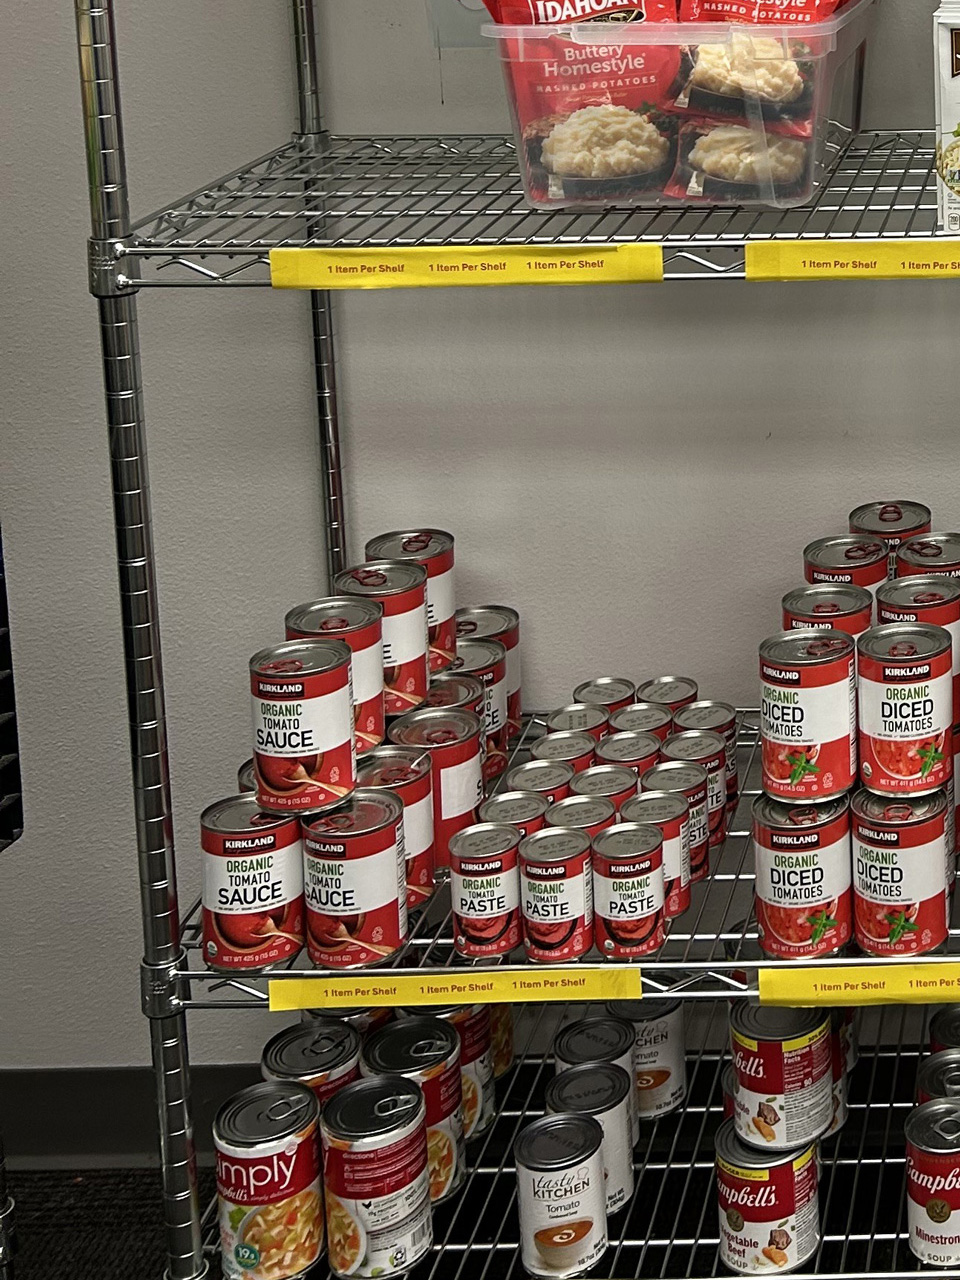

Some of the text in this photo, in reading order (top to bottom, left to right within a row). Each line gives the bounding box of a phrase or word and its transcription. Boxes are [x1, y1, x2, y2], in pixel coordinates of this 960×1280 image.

[564, 45, 624, 62] Buttery
[544, 55, 645, 77] Homestyle
[592, 75, 656, 88] POTATOES
[885, 666, 930, 675] KIRKLAND
[259, 683, 302, 692] KIRKLAND
[886, 685, 930, 700] ORGANIC
[261, 703, 302, 717] ORGANIC
[881, 698, 934, 719] DICED
[263, 717, 300, 730] TOMATO
[882, 718, 933, 732] TOMATOES
[256, 730, 313, 748] SAUCE
[461, 862, 501, 870] KIRKLAND
[462, 877, 500, 889] ORGANIC
[468, 890, 494, 898] TOMATO
[460, 896, 506, 912] PASTE
[821, 983, 841, 991] Item
[844, 982, 859, 990] Per
[861, 981, 886, 990] Shelf
[217, 1151, 296, 1195] imply
[533, 1178, 590, 1198] KITCHEN
[536, 1174, 575, 1189] tasty
[545, 1200, 580, 1213] Tomato
[727, 1242, 746, 1258] Beef
[726, 1256, 748, 1268] SOUP
[927, 1253, 952, 1262] SOUP
